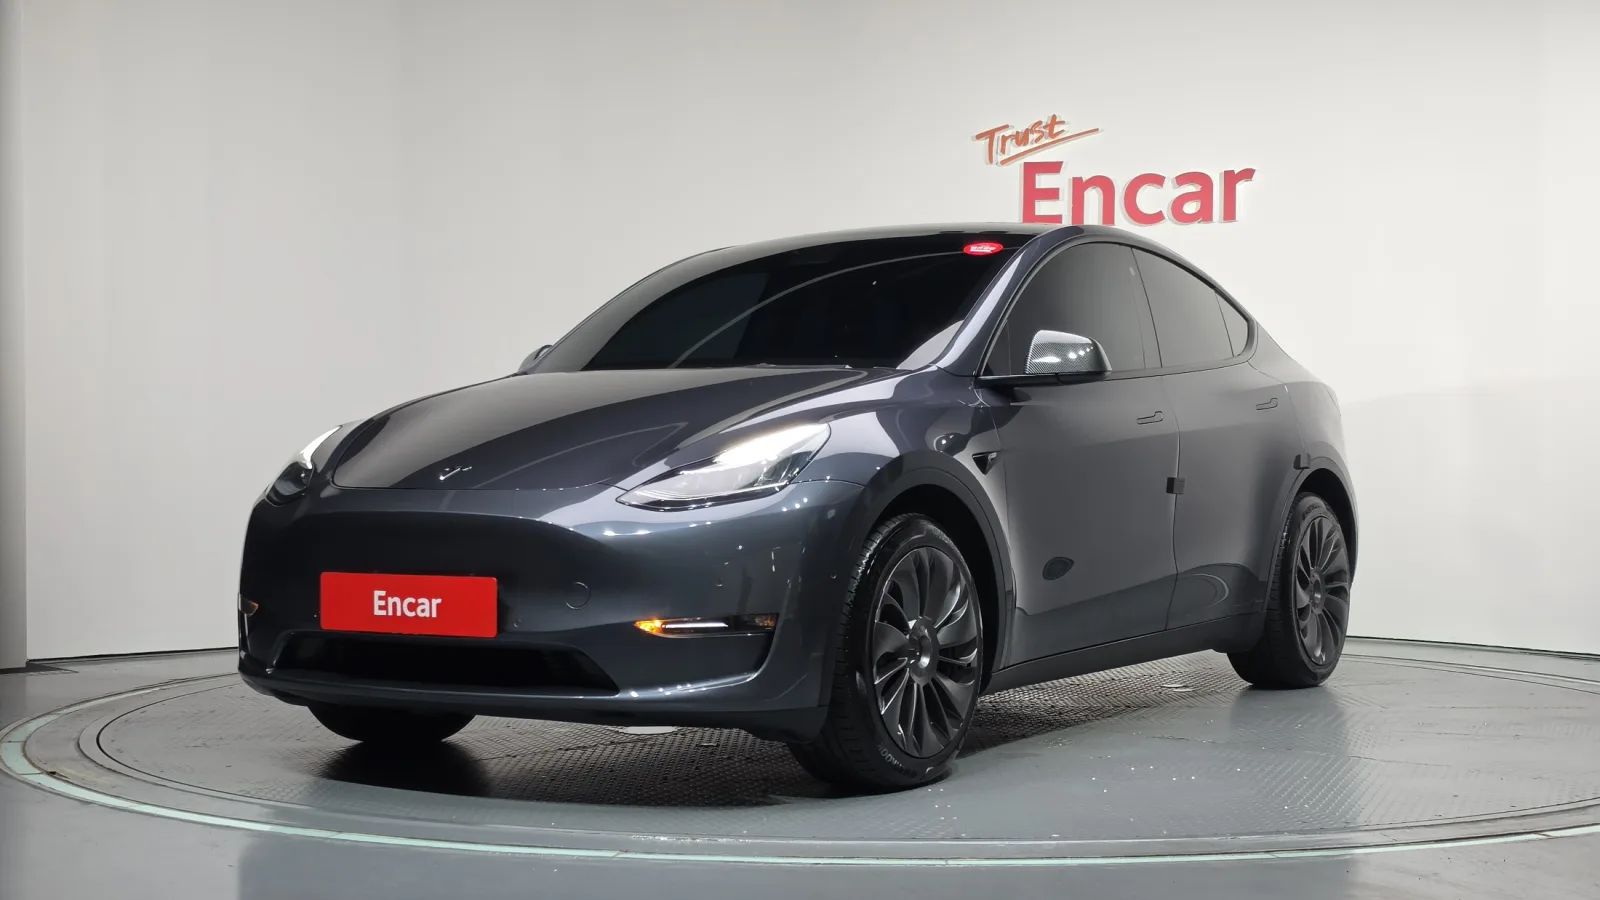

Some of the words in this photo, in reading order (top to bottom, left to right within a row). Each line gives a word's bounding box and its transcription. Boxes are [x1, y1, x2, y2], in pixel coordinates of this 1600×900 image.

[974, 113, 1066, 165] Trust
[1022, 160, 1256, 226] Encar
[373, 590, 442, 618] Encar
